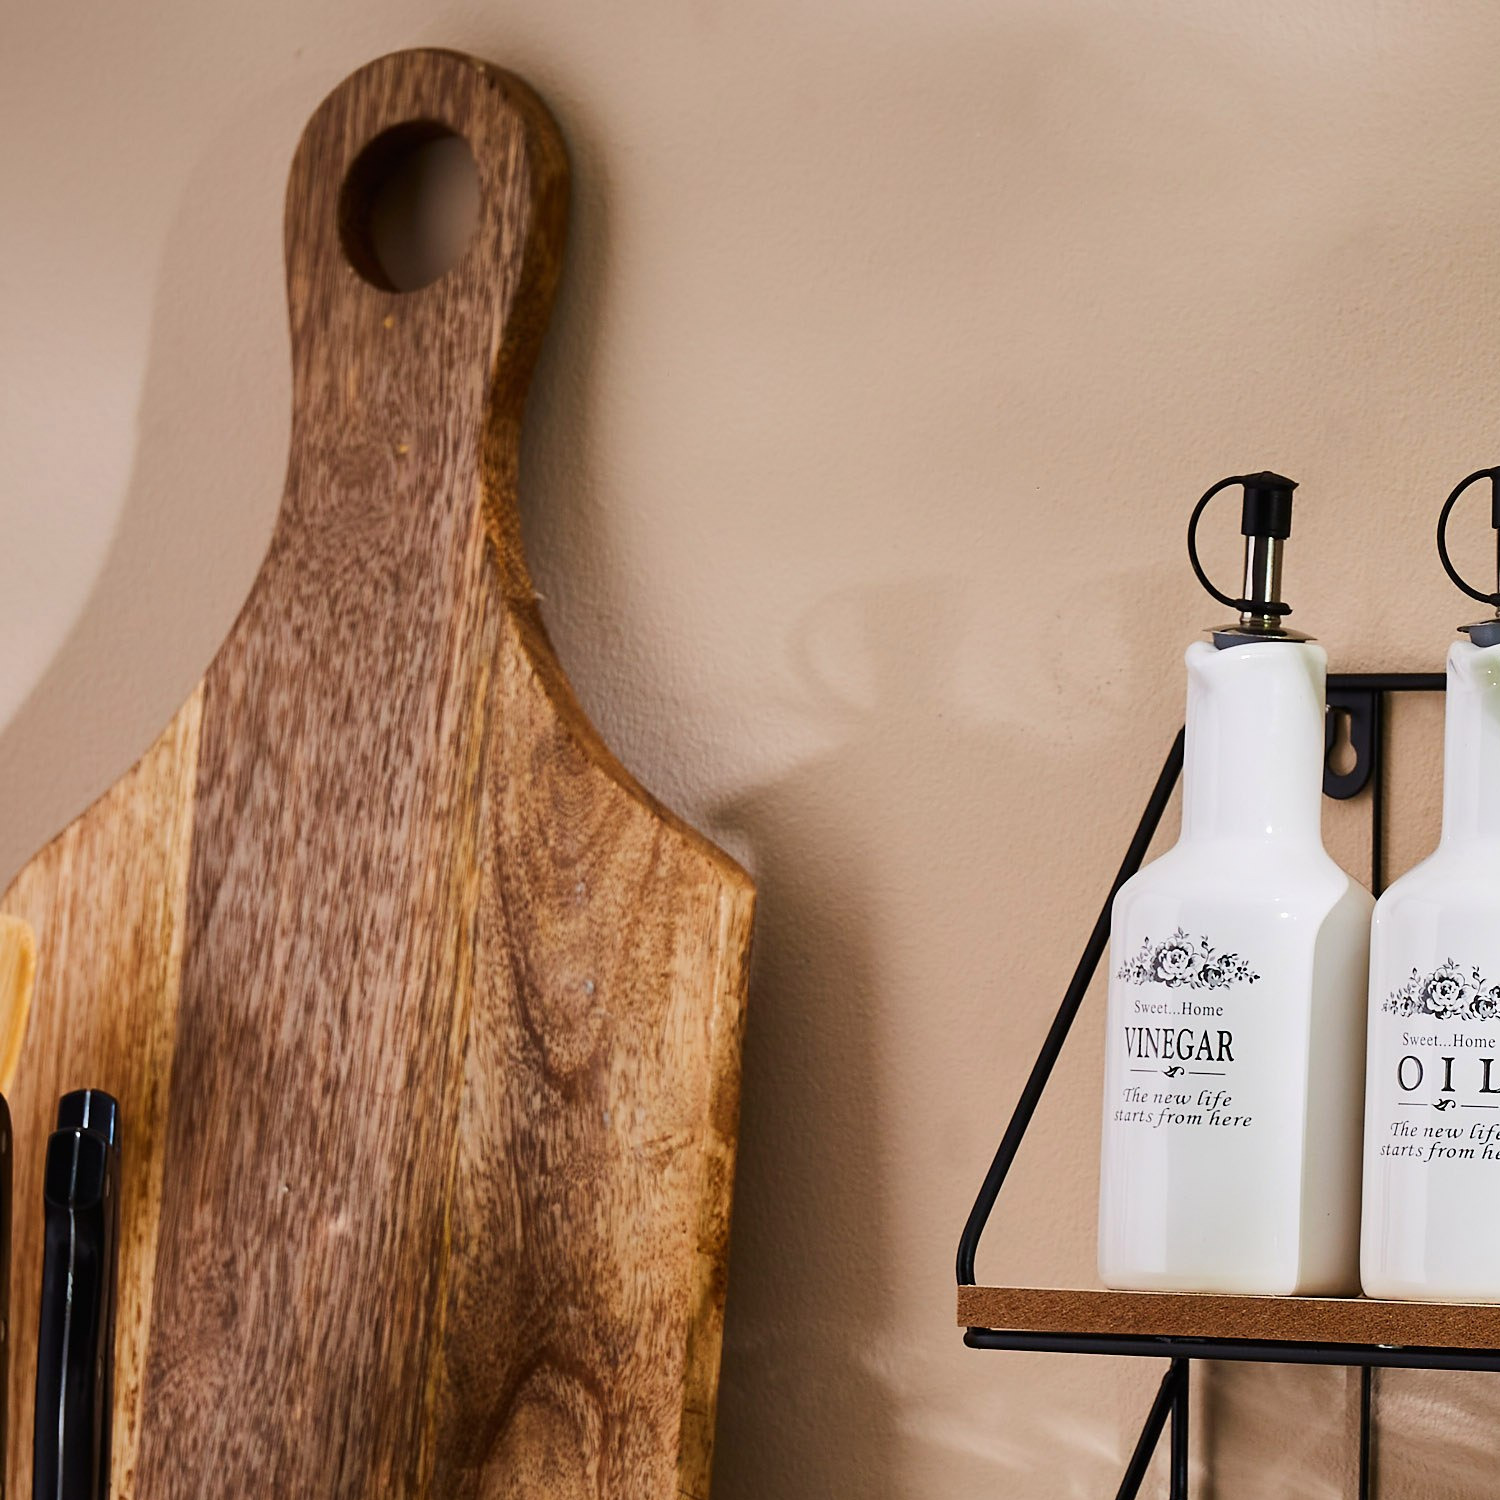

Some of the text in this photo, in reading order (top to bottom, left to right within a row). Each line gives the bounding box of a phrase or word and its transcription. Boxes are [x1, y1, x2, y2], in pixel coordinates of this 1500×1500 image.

[1125, 1027, 1234, 1062] VINEGAR
[1123, 1087, 1232, 1112] The new life
[1114, 1107, 1253, 1129] starts from here
[1390, 1120, 1418, 1138] The
[1423, 1125, 1464, 1140] new
[1380, 1142, 1424, 1157] starts
[1423, 1141, 1475, 1163] from
